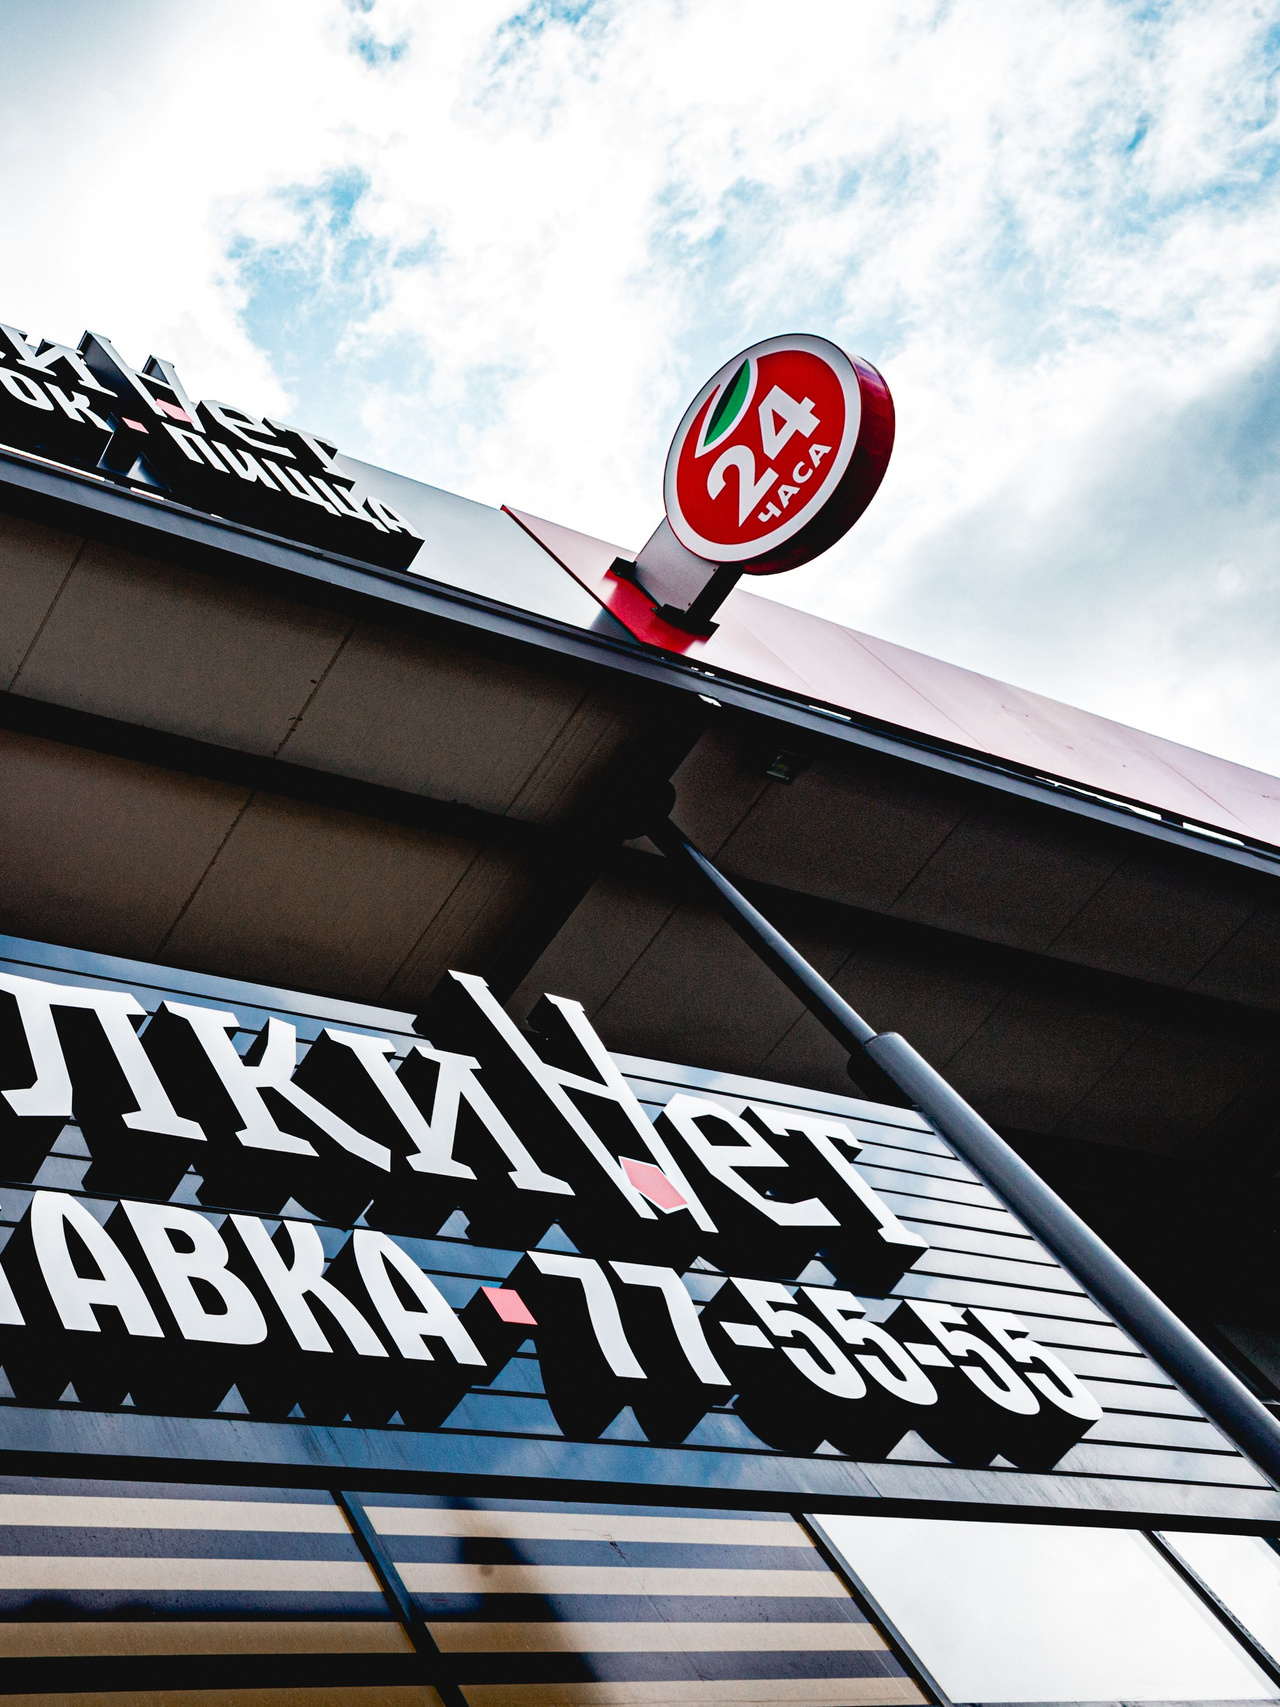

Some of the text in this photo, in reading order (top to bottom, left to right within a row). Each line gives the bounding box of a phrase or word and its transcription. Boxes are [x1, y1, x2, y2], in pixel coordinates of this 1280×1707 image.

[161, 421, 425, 542] ПИЦЦА
[706, 384, 822, 528] 24
[757, 443, 833, 523] ЧАСА
[526, 1249, 1104, 1422] 77-55-55
